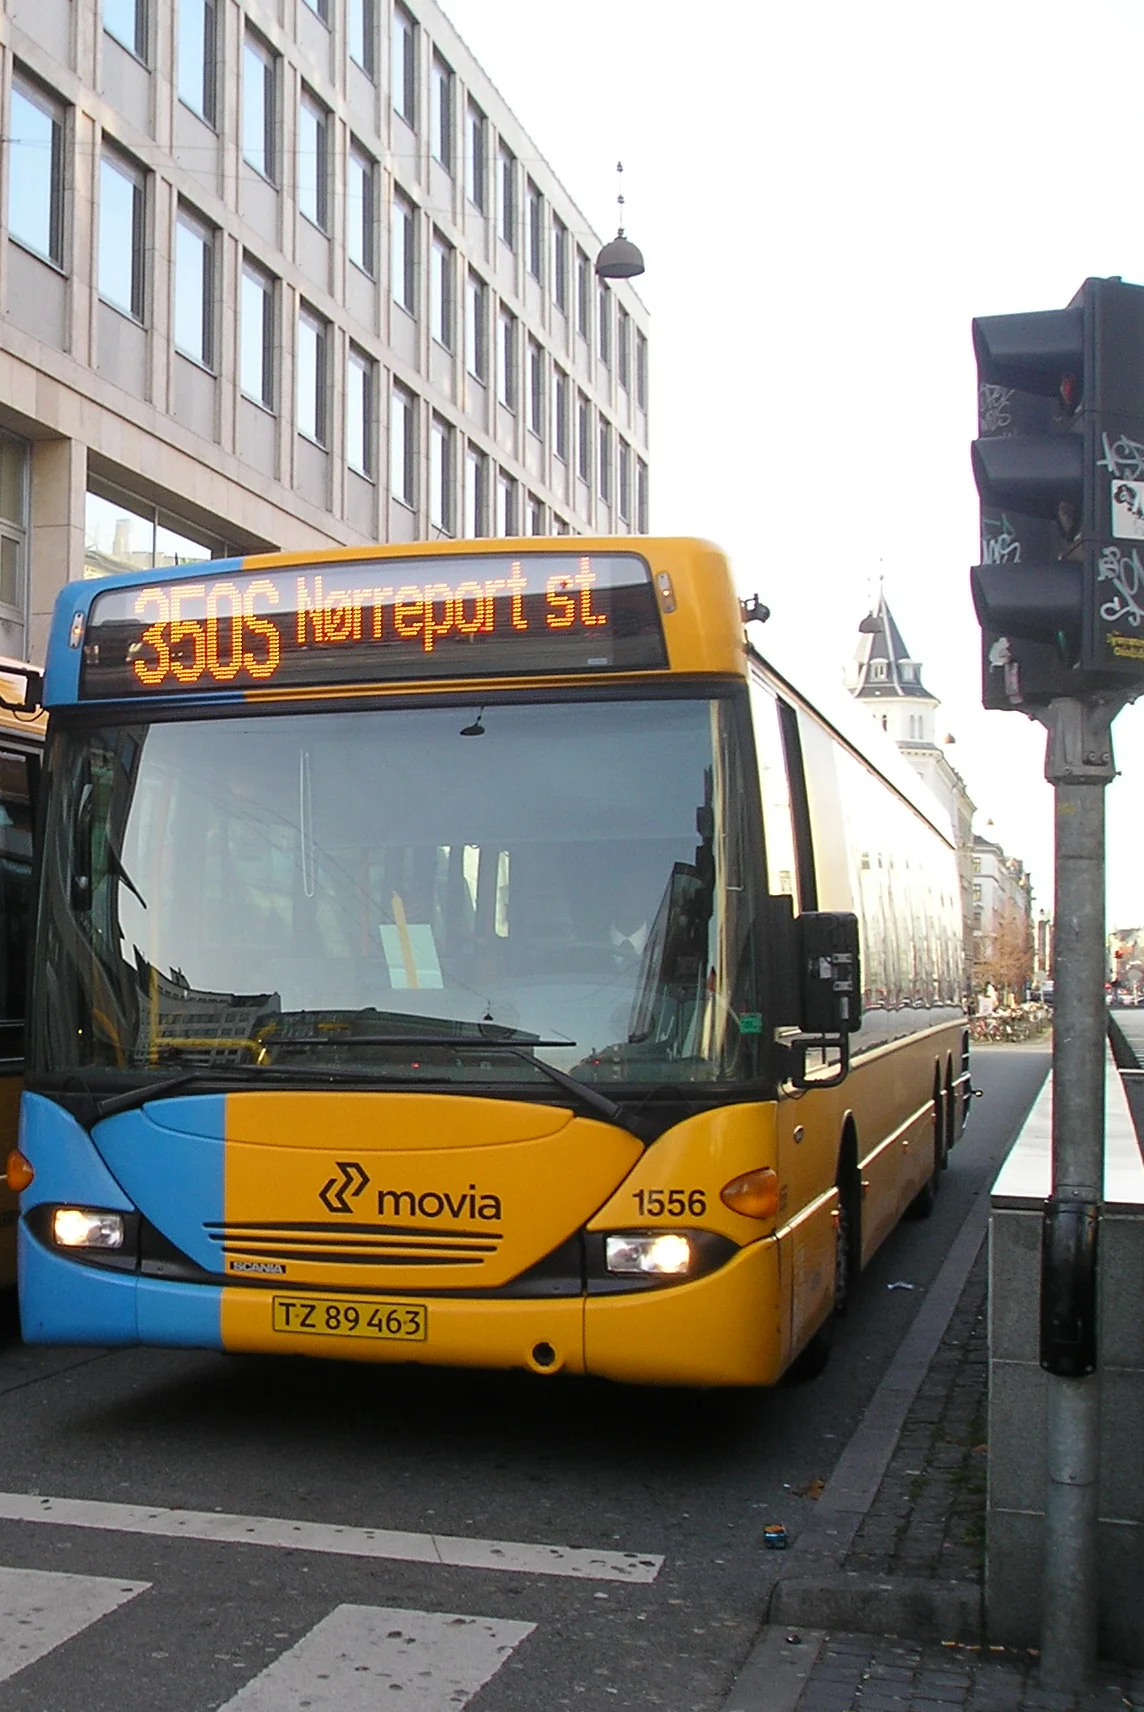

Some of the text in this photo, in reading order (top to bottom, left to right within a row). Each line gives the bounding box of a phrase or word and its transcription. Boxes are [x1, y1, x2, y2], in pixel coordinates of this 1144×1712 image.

[296, 561, 528, 652] Nørreport
[545, 556, 608, 628] st.
[377, 1183, 502, 1221] movia
[632, 1189, 707, 1217] 1556
[232, 1261, 284, 1274] SCANIA
[278, 1302, 421, 1336] TZ 89 463
